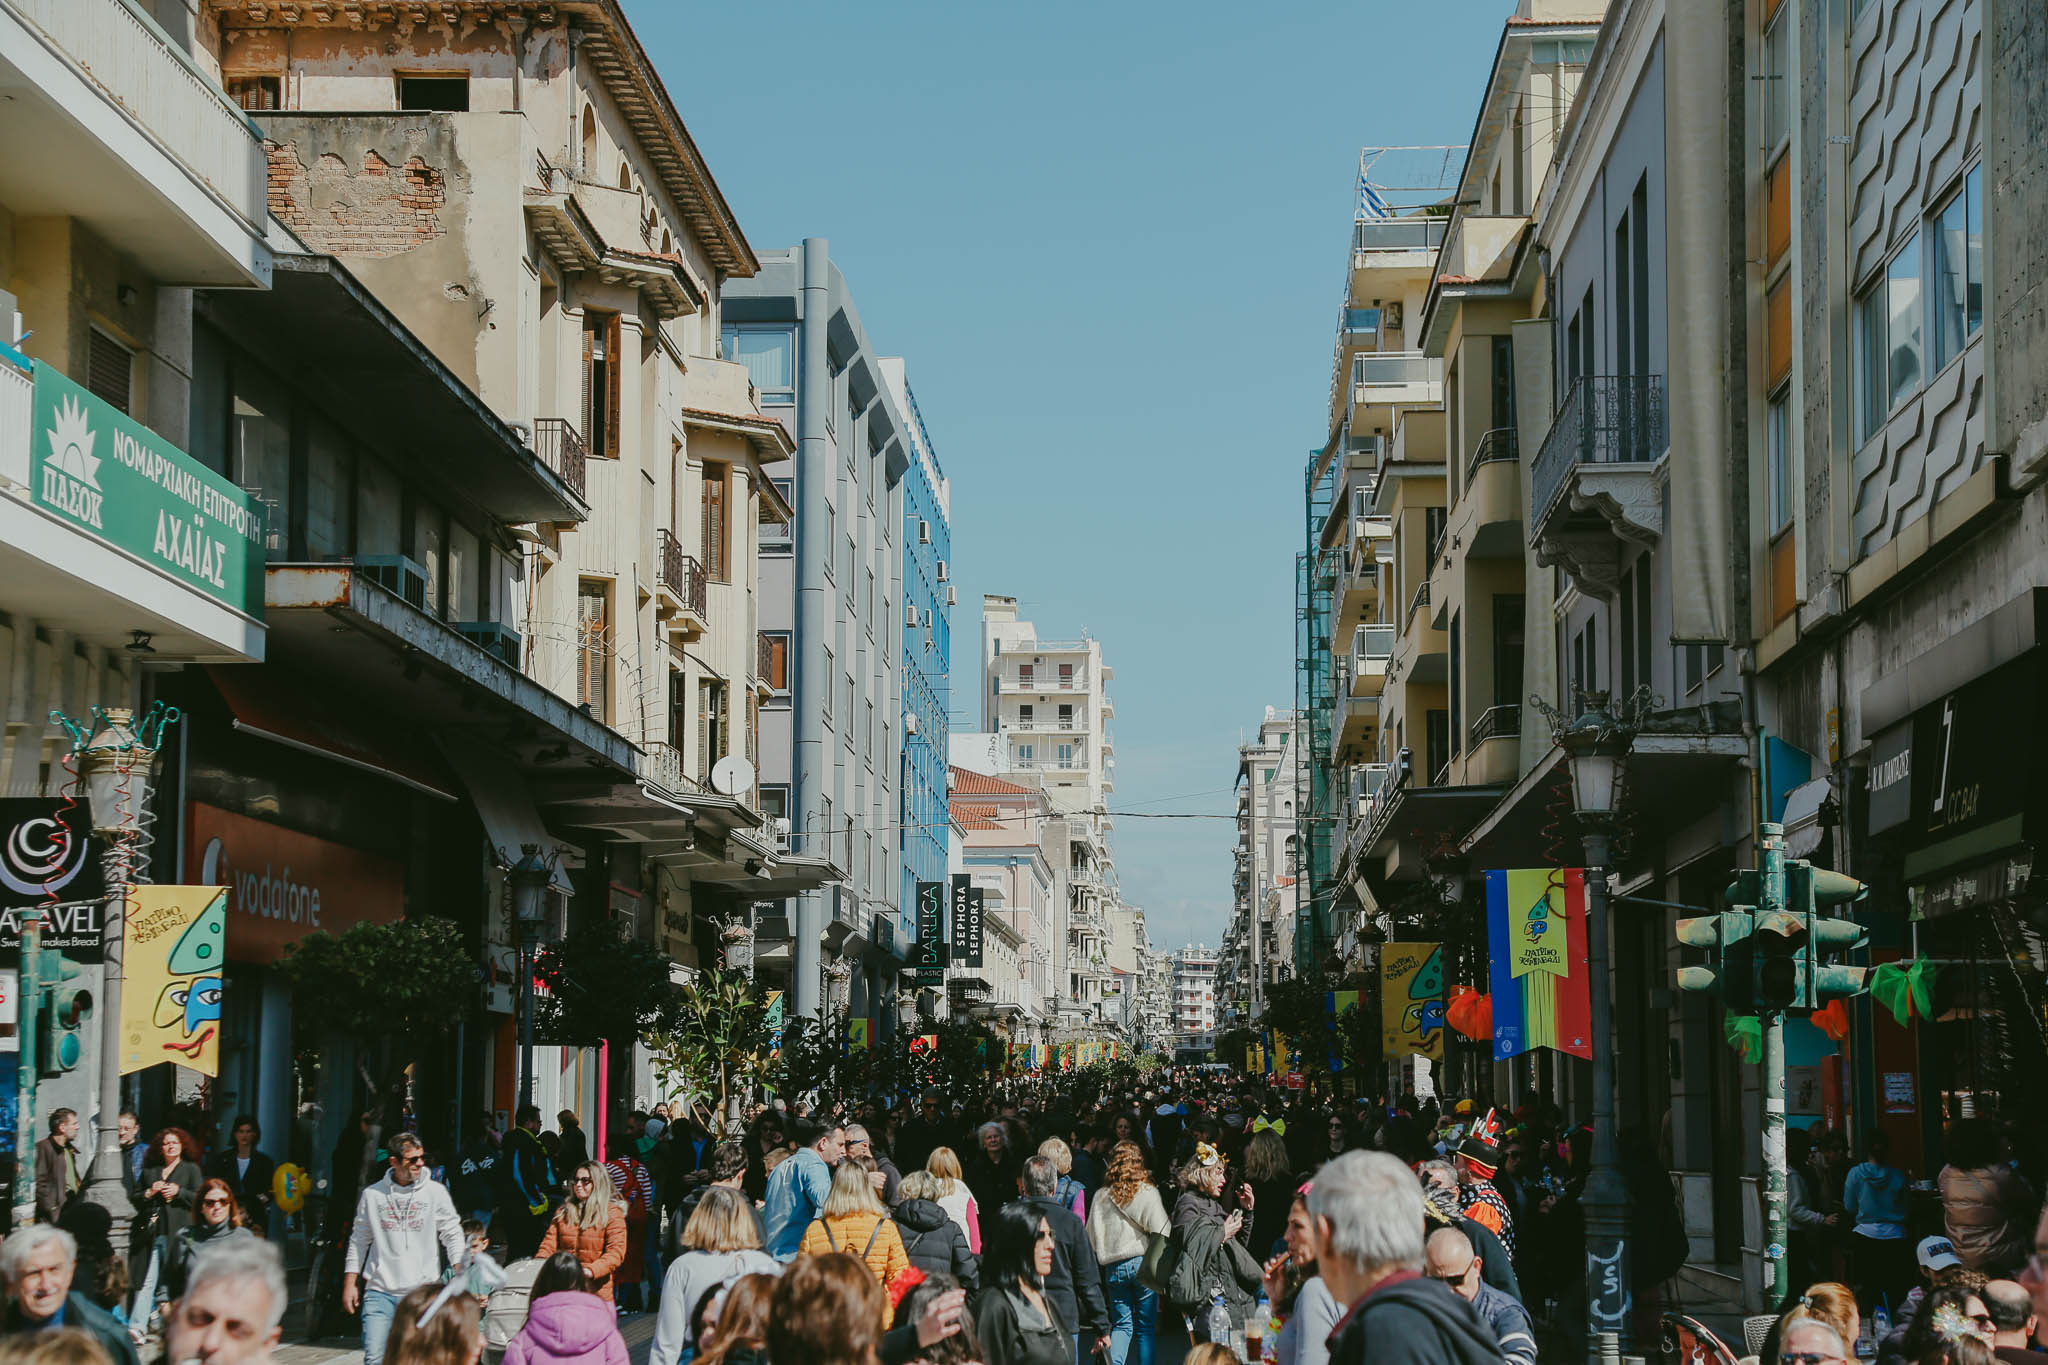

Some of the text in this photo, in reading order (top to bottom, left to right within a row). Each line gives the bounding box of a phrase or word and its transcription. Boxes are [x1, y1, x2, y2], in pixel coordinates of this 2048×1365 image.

[41, 465, 104, 529] ΠΑΣΟΚ
[113, 427, 261, 545] ΝΟΜΑΡΧΙΑΚΗ ΕΠΙΤΡΟΠΗ
[153, 508, 227, 589] ΑΧΑΪΑΣ
[0, 906, 102, 934] AAVEL
[235, 863, 321, 928] vodafone
[957, 886, 966, 946] SEPHORA
[0, 936, 99, 948] Swe makes Bread
[970, 899, 979, 956] SEPHORA
